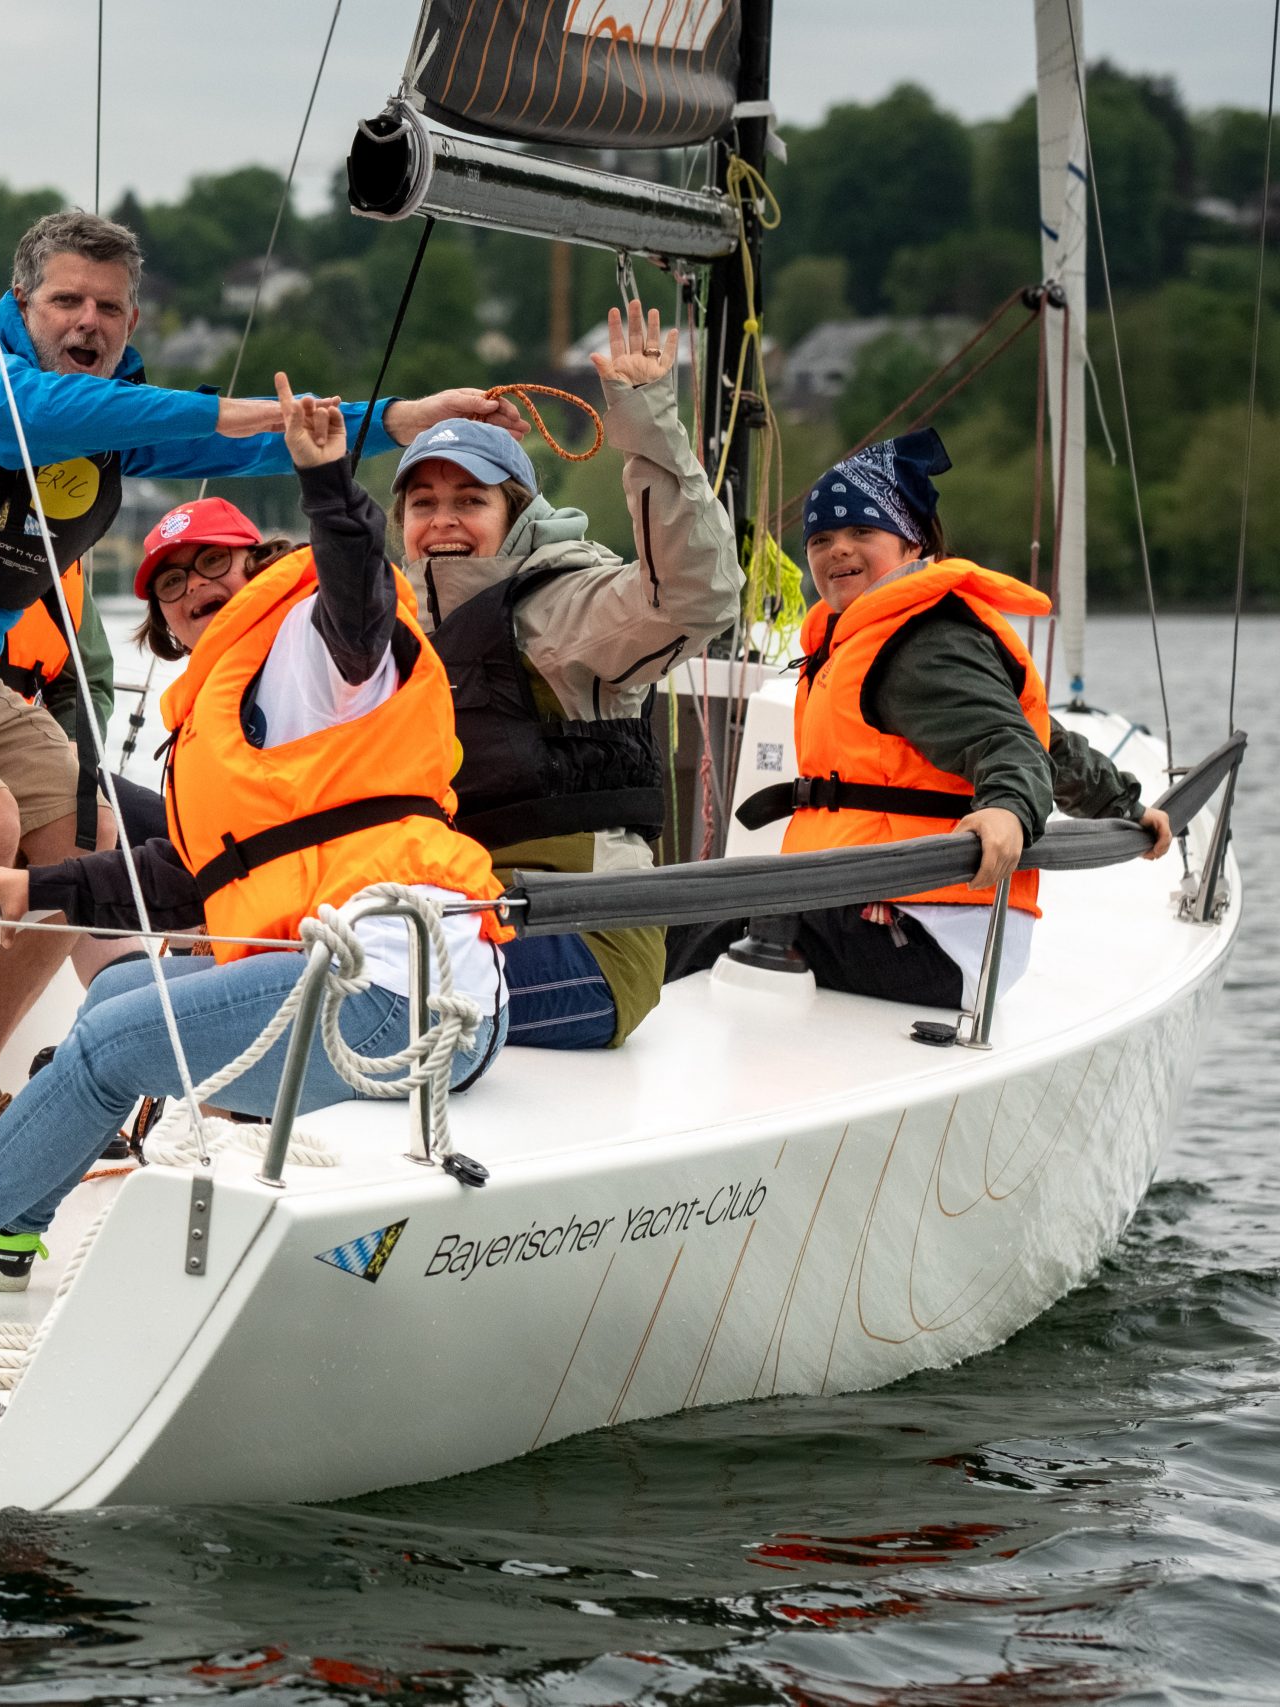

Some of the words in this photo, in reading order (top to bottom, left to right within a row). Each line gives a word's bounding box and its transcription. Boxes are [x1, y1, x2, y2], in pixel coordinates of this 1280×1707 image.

[36, 463, 88, 498] ERIC
[424, 1214, 615, 1281] Bayerischer
[620, 1177, 767, 1243] Yacht-Club
